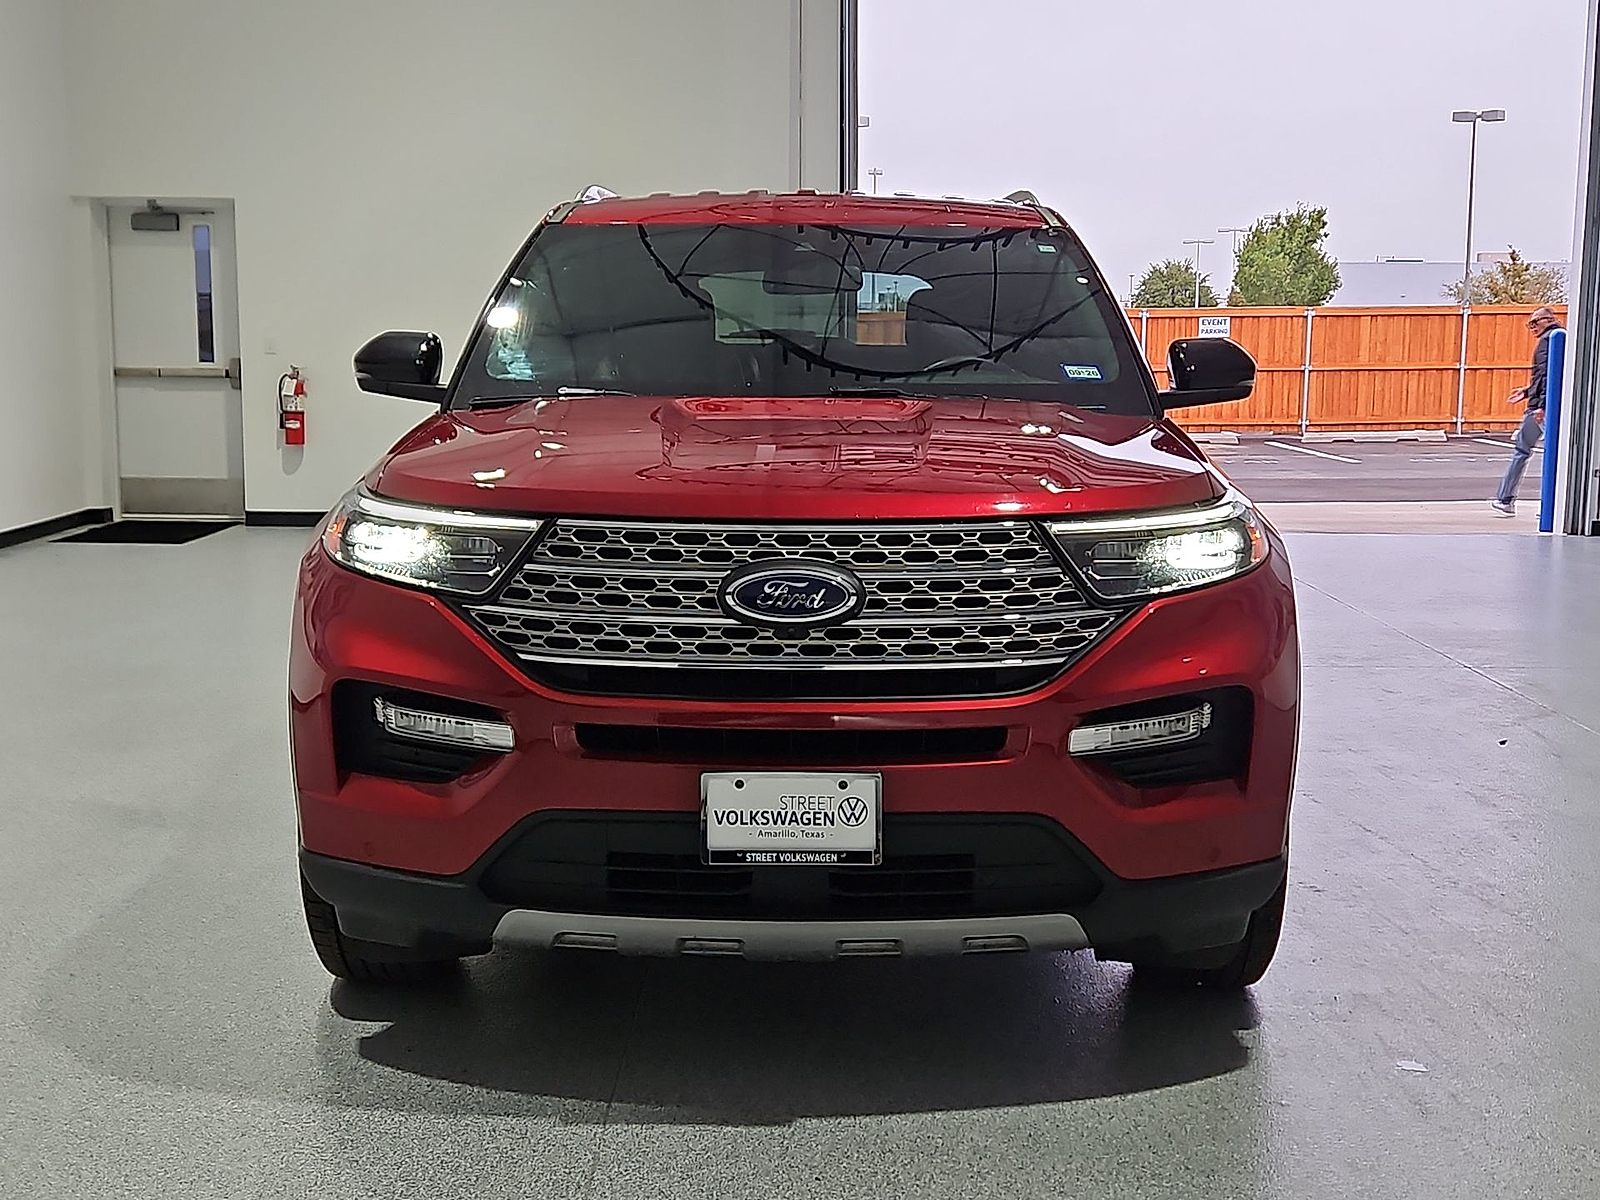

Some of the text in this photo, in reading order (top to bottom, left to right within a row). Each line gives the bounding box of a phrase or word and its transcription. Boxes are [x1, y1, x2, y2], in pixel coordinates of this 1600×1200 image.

[1201, 318, 1228, 326] EVENT
[756, 579, 827, 609] Ford
[779, 795, 836, 811] STREET
[713, 810, 836, 827] VOLKSWAGEN
[757, 829, 826, 840] Amarillo, Texas
[745, 852, 838, 863] STREET VOLKSWAGEN
